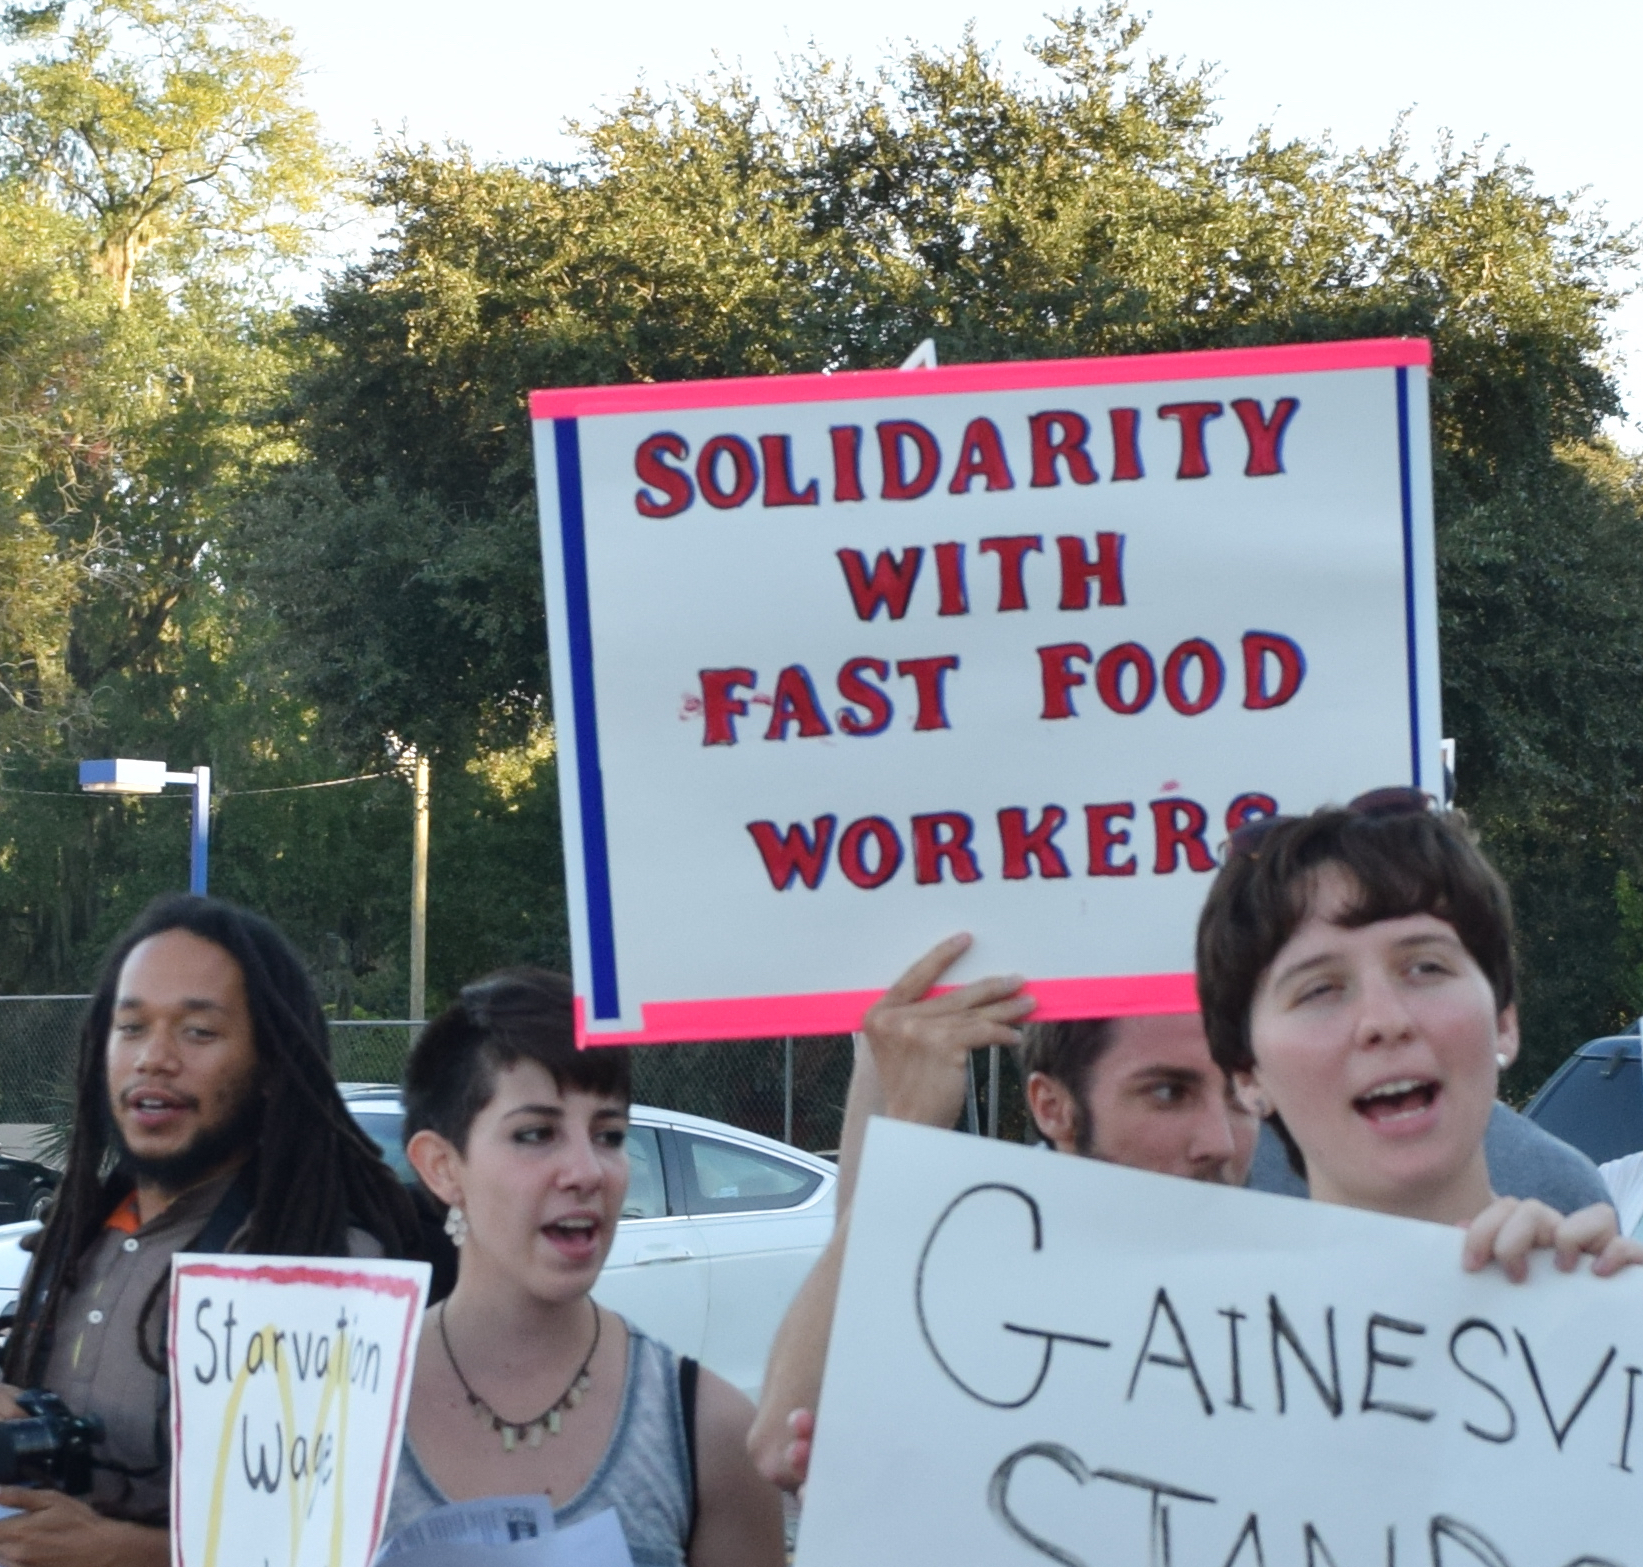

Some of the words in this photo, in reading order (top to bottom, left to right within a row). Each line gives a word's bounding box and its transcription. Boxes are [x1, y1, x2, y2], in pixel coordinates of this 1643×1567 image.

[635, 397, 1300, 519] SOLIDARITY
[837, 532, 1126, 621] WITH
[696, 655, 959, 747] FAST
[1037, 630, 1306, 721] FOOD
